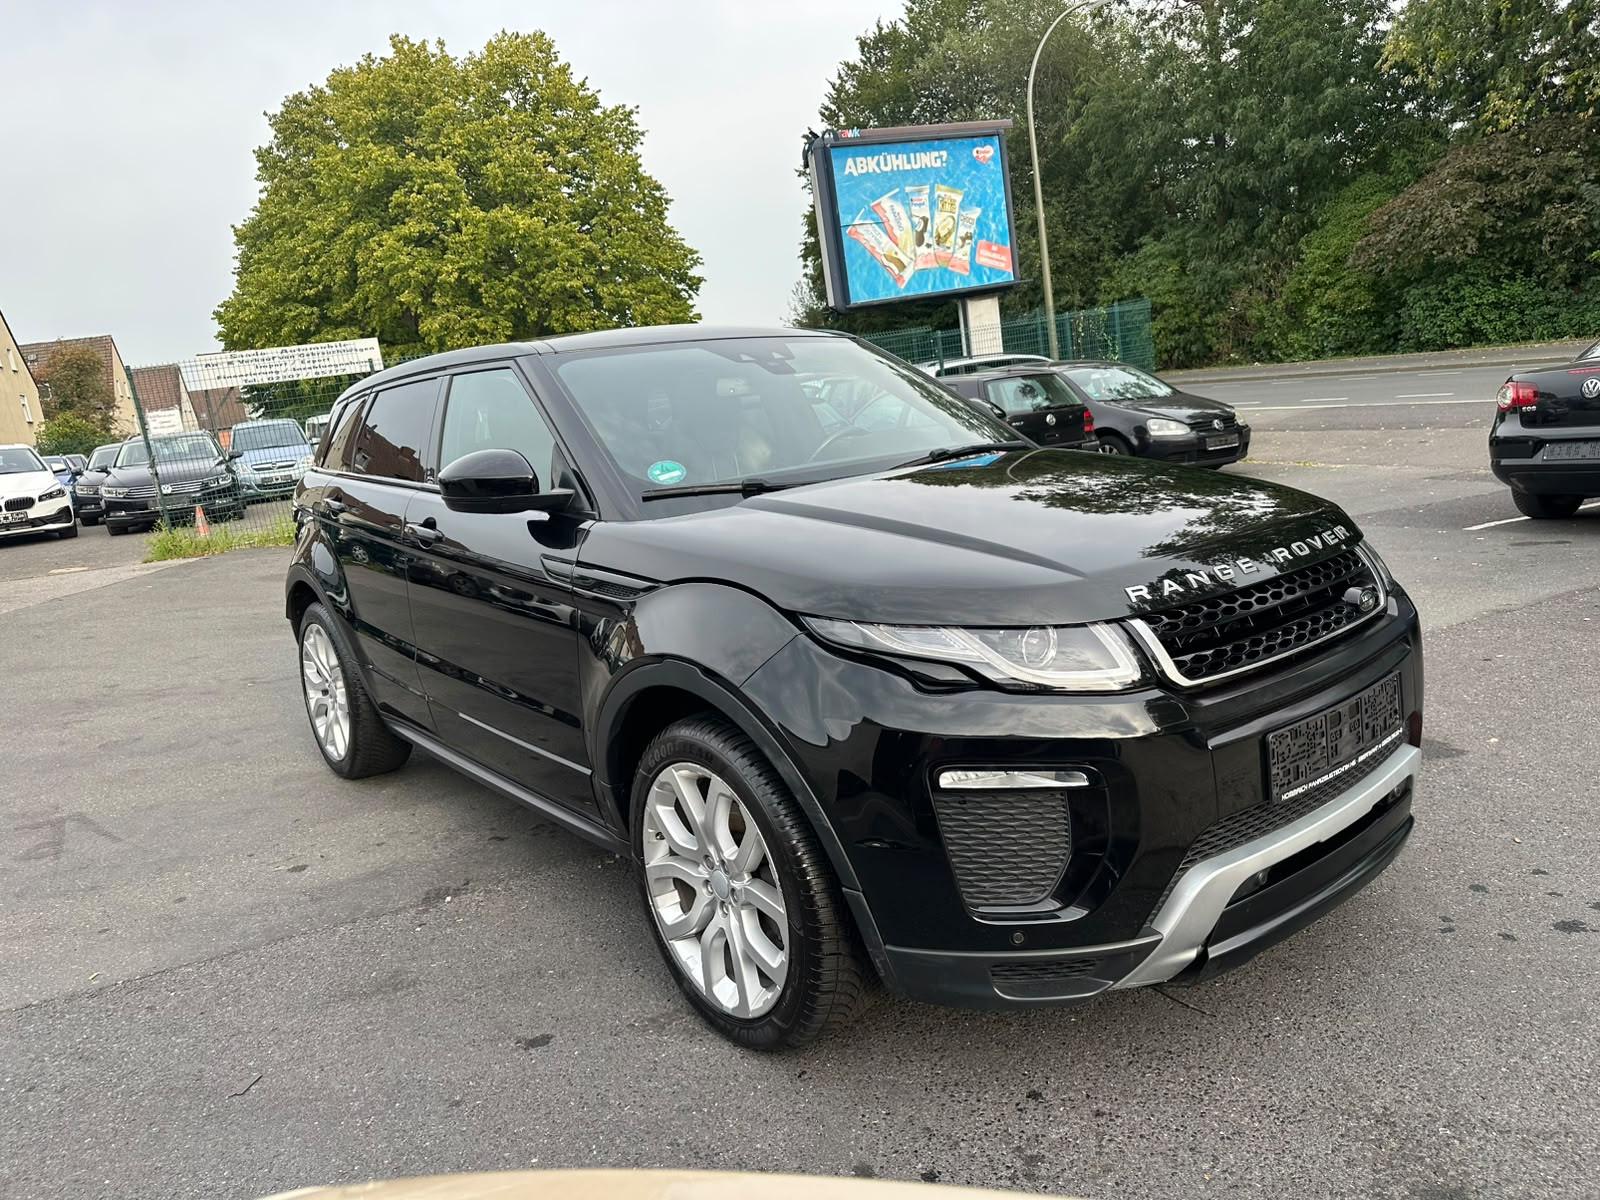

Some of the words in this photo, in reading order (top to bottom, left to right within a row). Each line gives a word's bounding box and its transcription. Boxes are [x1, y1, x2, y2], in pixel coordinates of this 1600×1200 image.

[841, 129, 861, 139] awk
[844, 150, 947, 176] ABKÜHLUNG?
[1124, 557, 1258, 602] RANGE
[1272, 525, 1351, 562] ROVER
